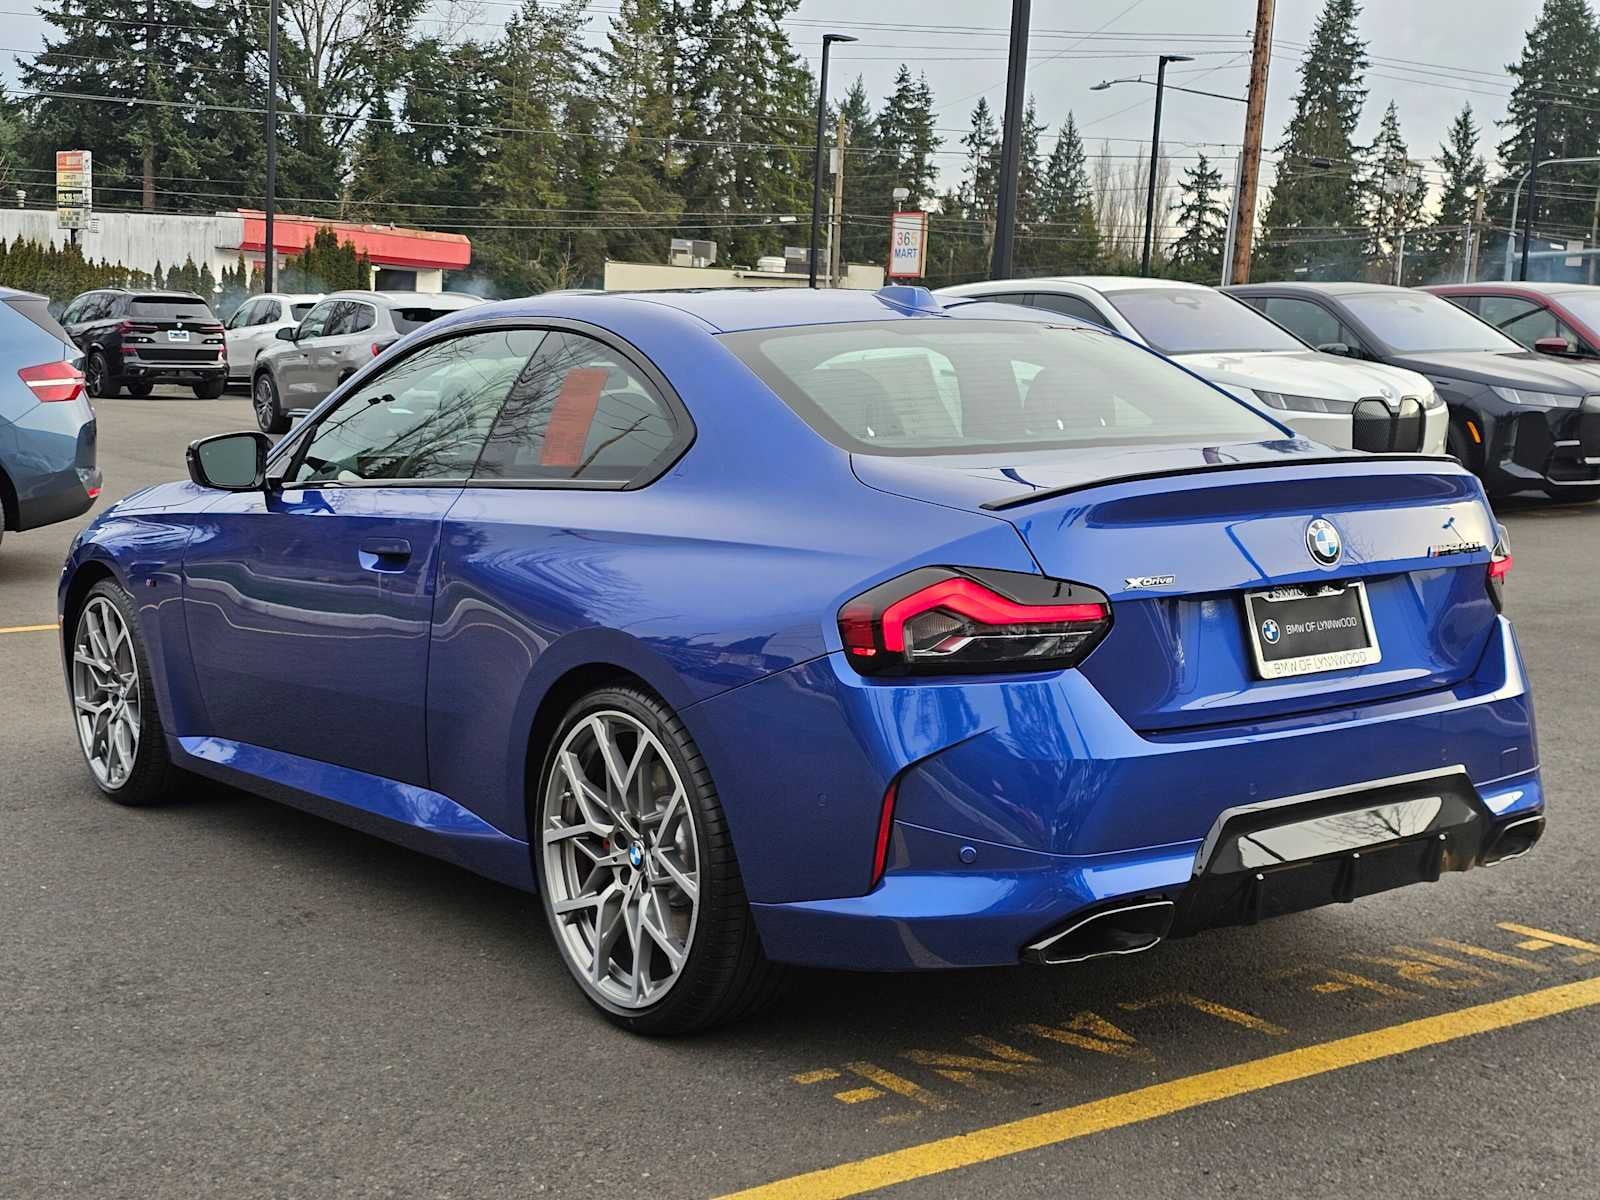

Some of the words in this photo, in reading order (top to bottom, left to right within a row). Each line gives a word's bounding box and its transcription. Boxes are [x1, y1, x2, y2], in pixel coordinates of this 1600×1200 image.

[895, 248, 918, 258] MART
[1286, 623, 1304, 634] BMW
[1305, 622, 1316, 632] OF
[1317, 617, 1357, 630] LYNNWOOD
[1273, 660, 1297, 675] BMW
[1299, 658, 1312, 671] OF
[1313, 651, 1367, 668] LYNNWOOD
